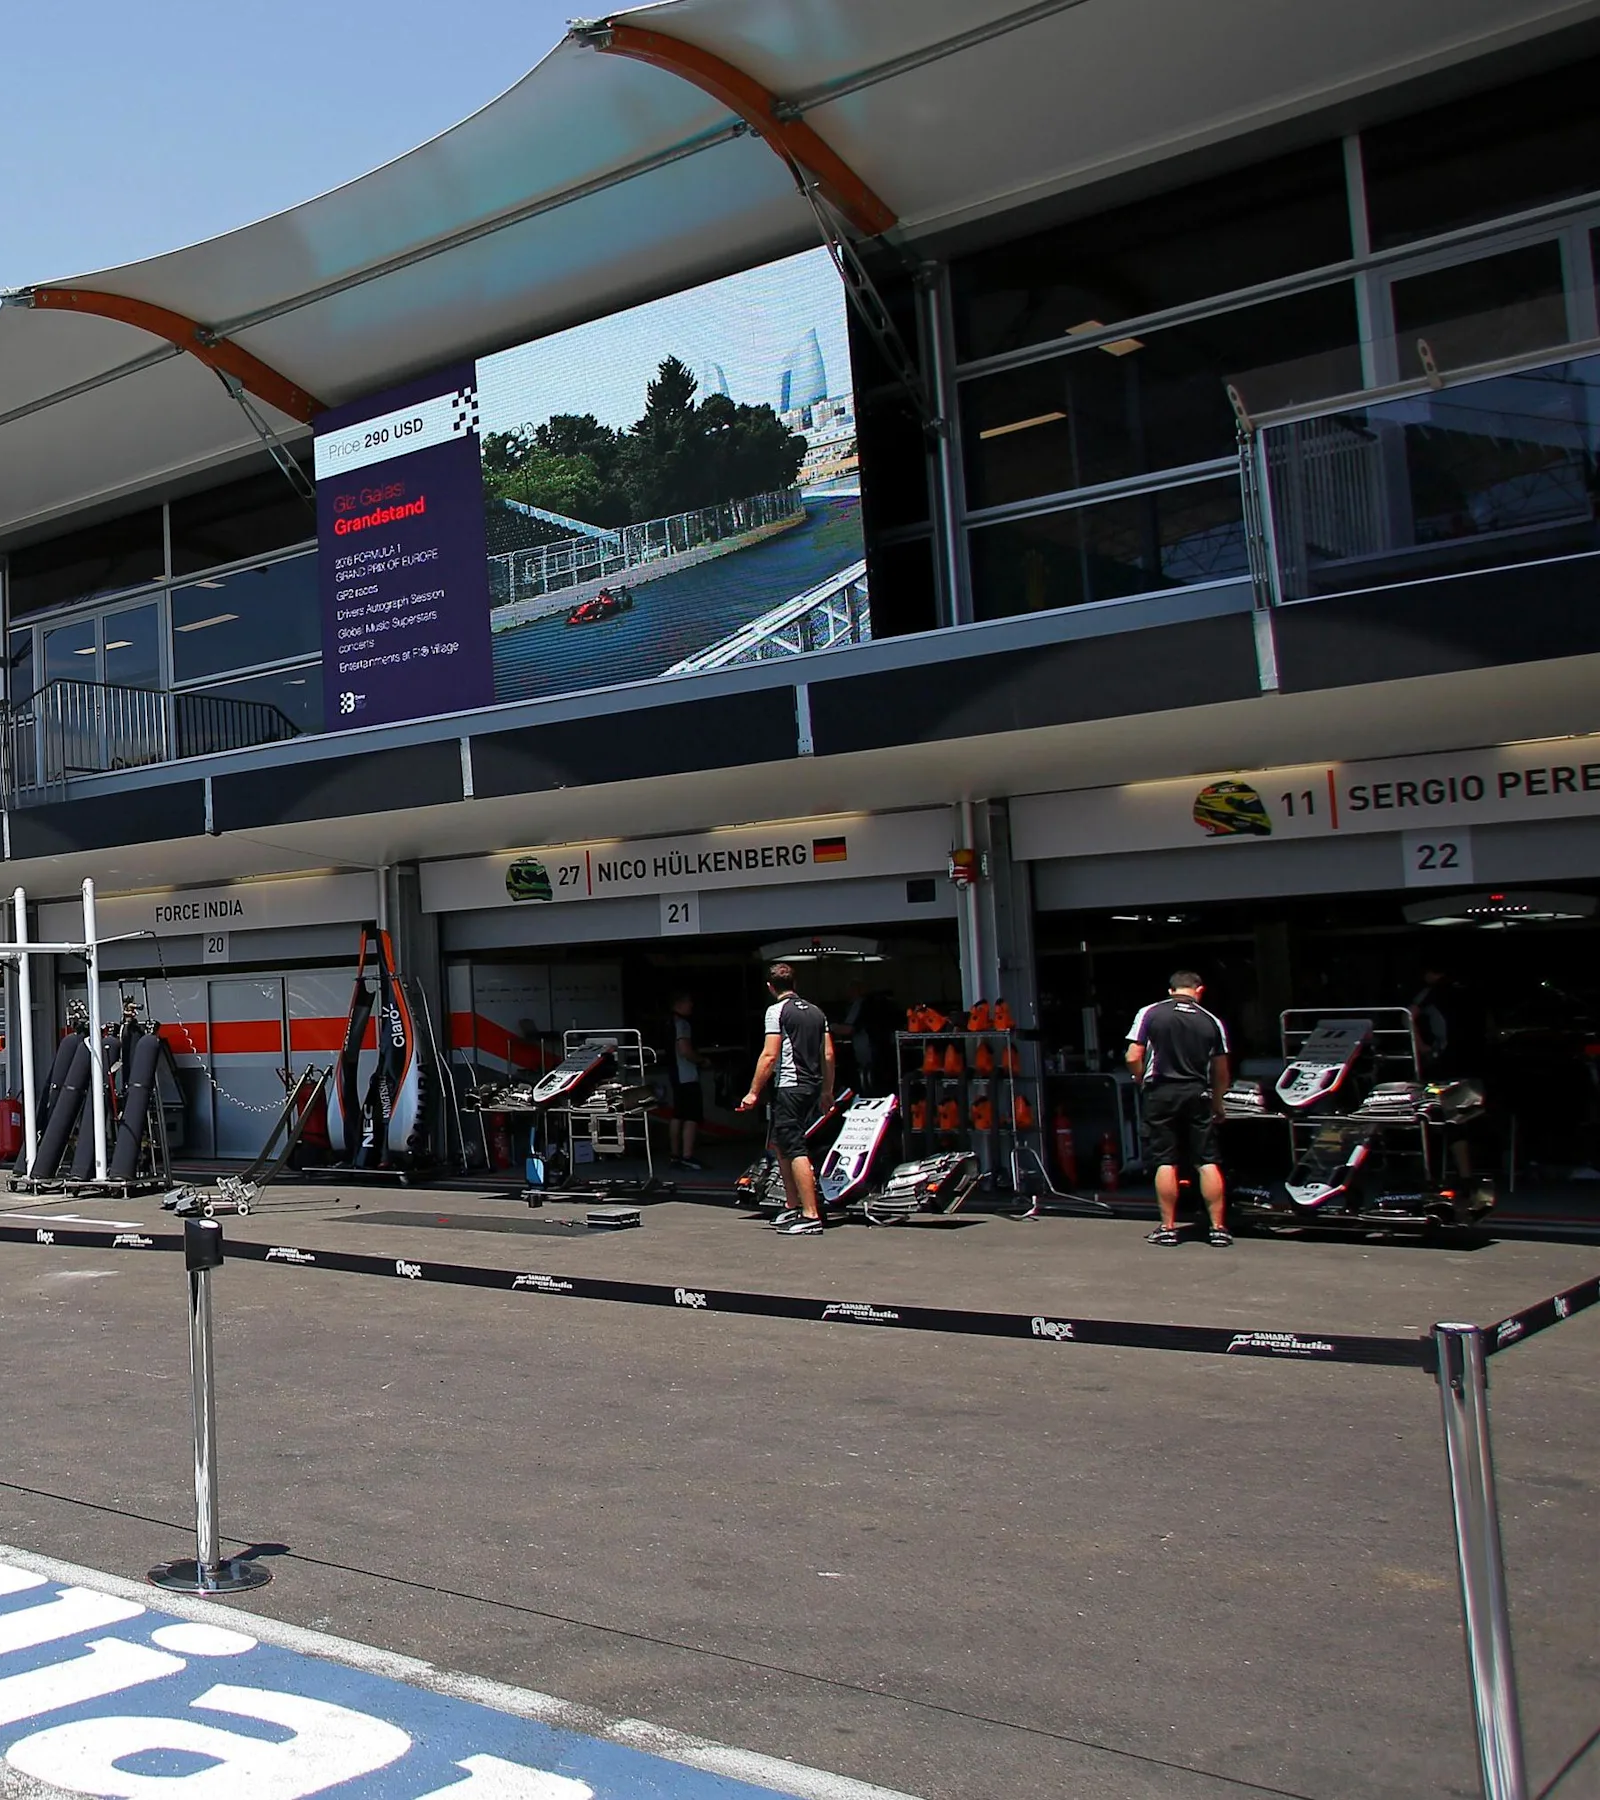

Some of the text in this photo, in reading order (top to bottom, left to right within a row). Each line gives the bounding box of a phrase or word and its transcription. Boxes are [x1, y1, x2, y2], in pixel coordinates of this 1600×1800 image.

[329, 418, 424, 459] Price 290 USD
[334, 496, 427, 535] Grandstand
[335, 567, 366, 583] GRAND
[387, 557, 399, 570] OF
[401, 548, 438, 567] EUROPE
[354, 544, 395, 564] FORMULA
[336, 588, 354, 601] GP2
[365, 596, 409, 614] Autograph
[410, 589, 445, 604] Session
[365, 620, 390, 633] Music
[391, 610, 438, 628] Superstars
[1280, 790, 1314, 817] 11
[1348, 775, 1484, 812] SERGIO
[558, 843, 807, 886] 27 NICO HÜLKENBERG
[1416, 843, 1458, 870] 22
[155, 899, 244, 923] FORCE INDIA
[667, 903, 689, 924] 21
[208, 937, 224, 954] 20
[390, 1009, 405, 1048] Claro
[854, 1100, 885, 1110] 27
[362, 1104, 374, 1148] NEC
[36, 1229, 55, 1245] flex
[396, 1260, 421, 1279] flex
[674, 1288, 707, 1309] flex
[1031, 1317, 1073, 1341] flex
